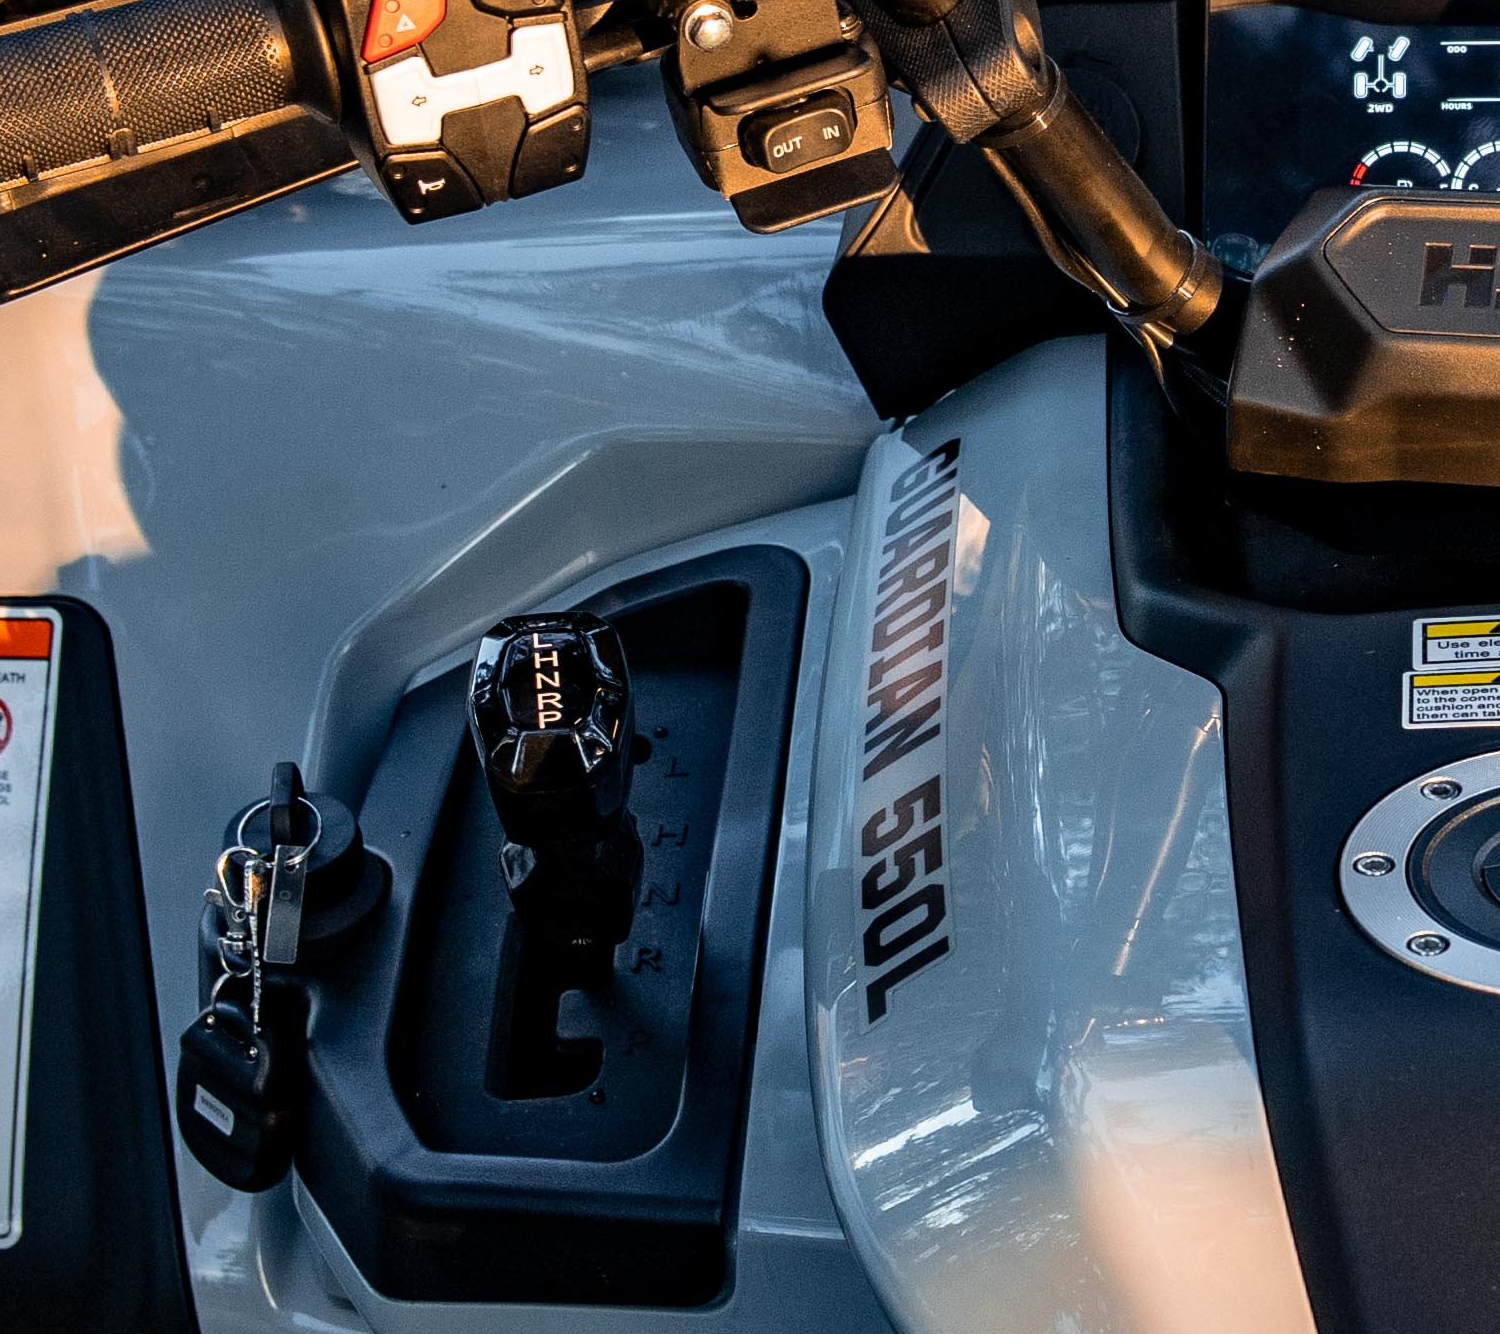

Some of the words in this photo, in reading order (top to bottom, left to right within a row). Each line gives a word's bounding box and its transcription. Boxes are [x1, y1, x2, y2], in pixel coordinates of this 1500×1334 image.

[1447, 46, 1467, 54] ODO
[1367, 104, 1394, 113] 2WD
[1441, 103, 1473, 111] HOURS
[773, 136, 803, 158] OUT
[822, 125, 840, 140] IN
[863, 438, 960, 782] GUARDIAN
[532, 632, 553, 649] L
[1437, 640, 1470, 650] Use
[533, 652, 559, 668] H
[1454, 649, 1490, 659] time
[535, 672, 560, 688] N
[1417, 688, 1458, 697] When
[1462, 687, 1498, 696] open
[1417, 696, 1430, 704] to
[1433, 696, 1456, 704] the
[537, 693, 563, 709] R
[1416, 703, 1473, 711] cushion
[539, 712, 563, 728] P
[651, 825, 689, 846] H
[642, 883, 680, 907] N
[861, 772, 956, 1024] 550L
[632, 947, 662, 973] R
